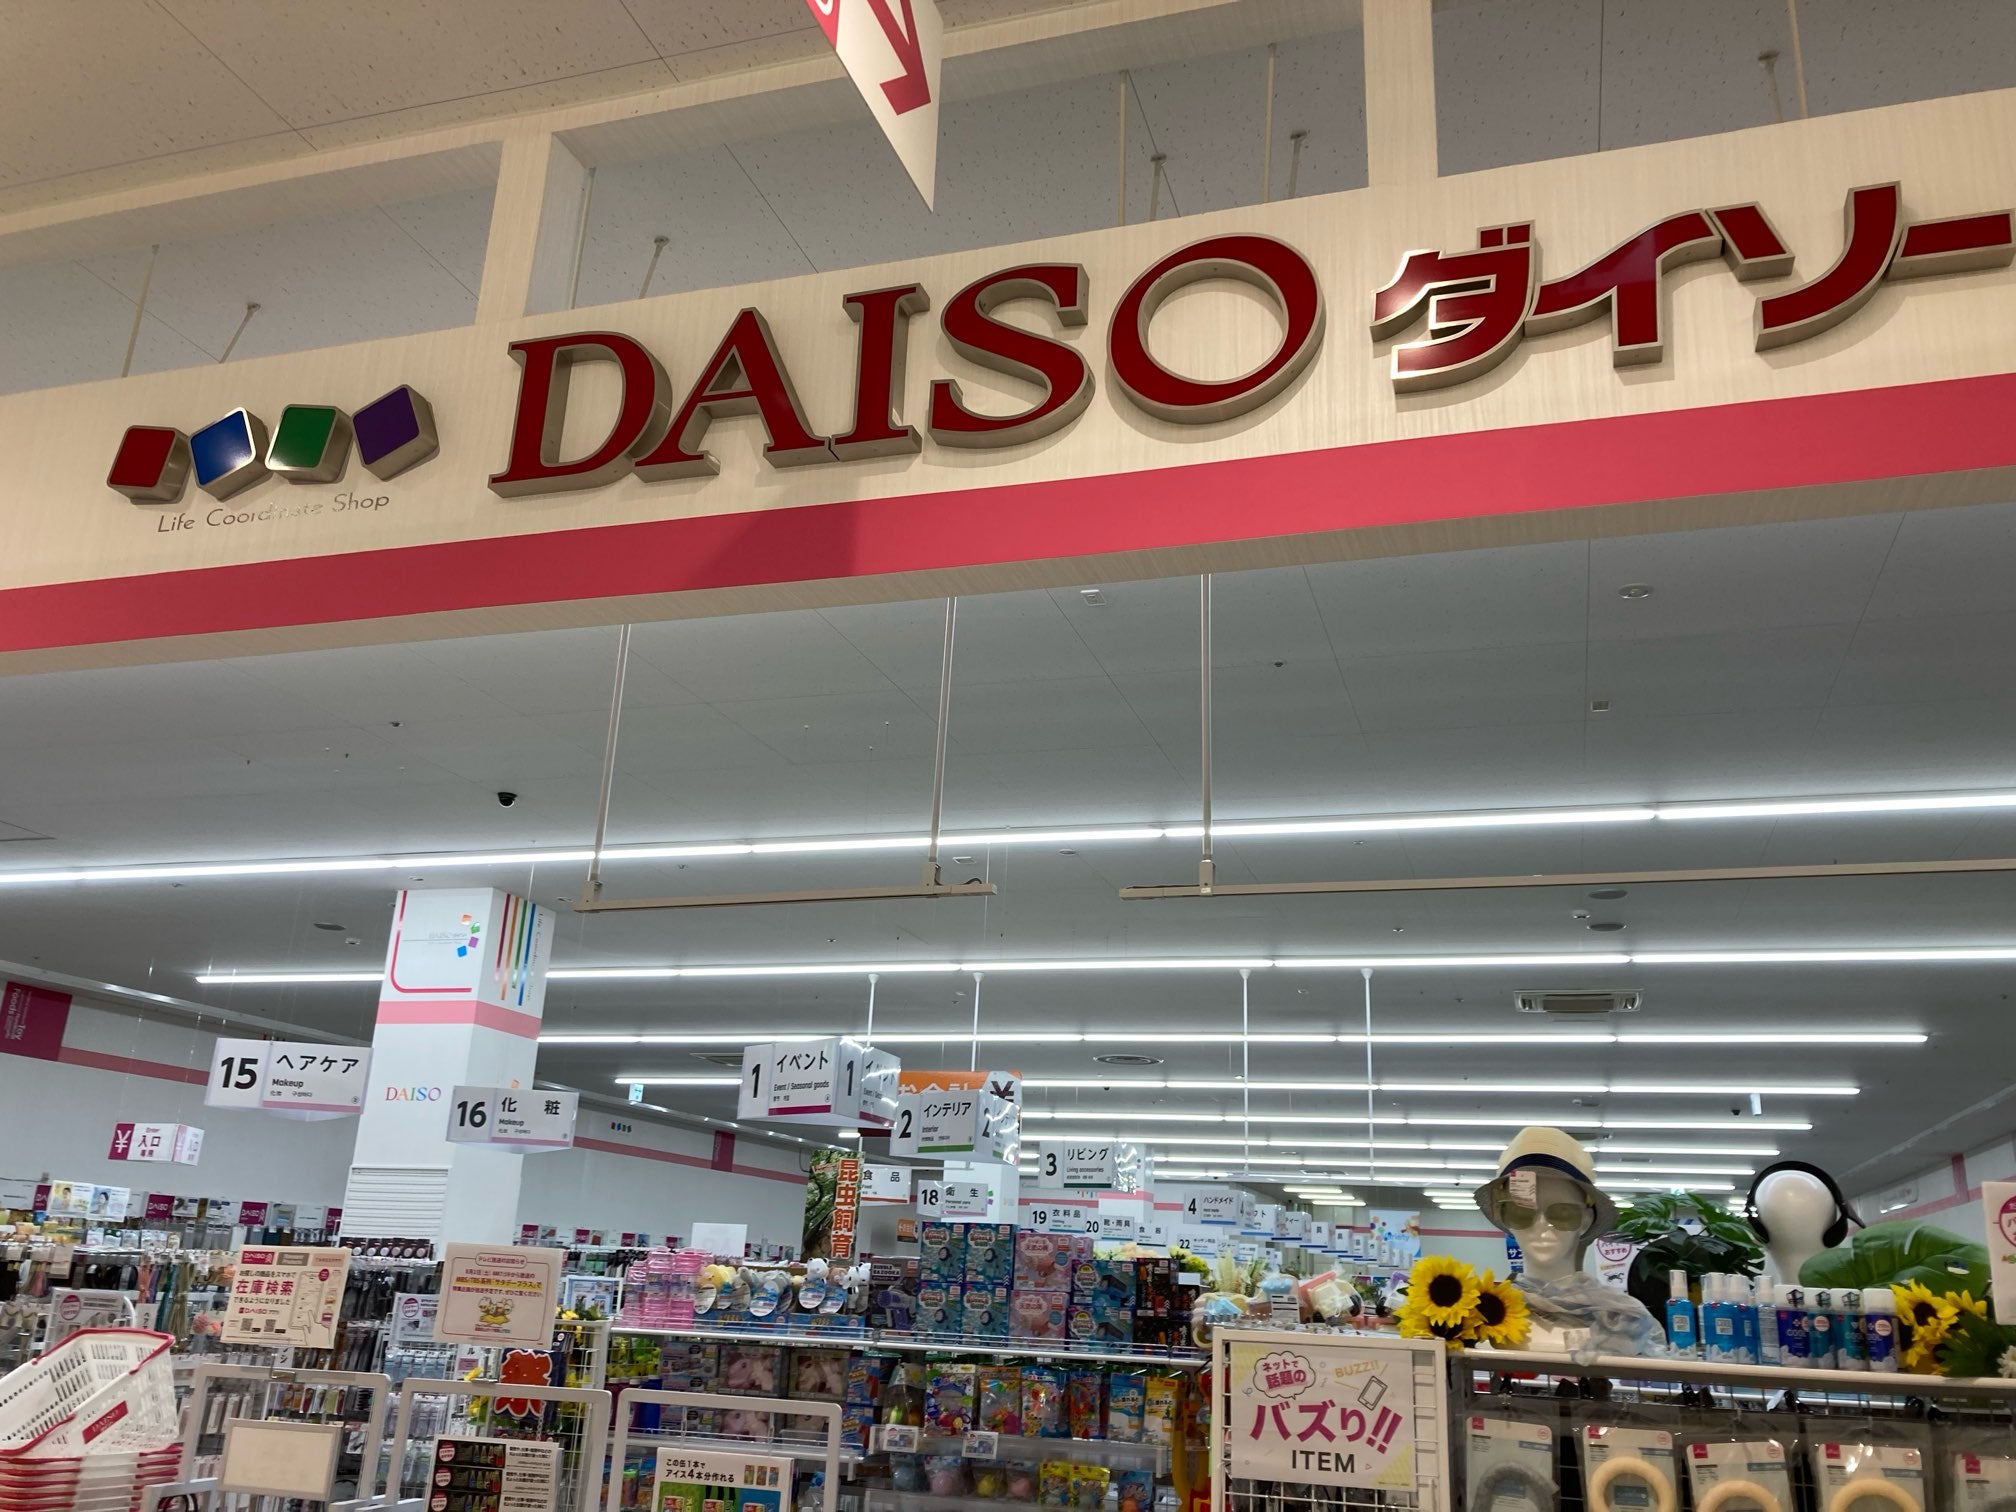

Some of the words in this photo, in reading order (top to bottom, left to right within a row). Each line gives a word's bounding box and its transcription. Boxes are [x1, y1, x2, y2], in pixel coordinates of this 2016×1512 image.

[1370, 181, 2015, 394] ダイソー
[488, 232, 1326, 497] DAISO
[157, 512, 195, 533] Life
[206, 503, 323, 526] Coordinate
[332, 493, 390, 513] Shop
[276, 1054, 359, 1074] ヘアケア
[776, 1050, 828, 1073] イベント
[221, 1057, 258, 1089] 15
[752, 1063, 761, 1098] 1
[847, 1060, 854, 1096] 1
[272, 1078, 304, 1088] Makeup
[773, 1083, 787, 1091] Event
[791, 1080, 813, 1090] Seasonal
[814, 1080, 829, 1090] goods
[384, 1086, 442, 1102] DAISO
[501, 1097, 561, 1115] 化粧
[923, 1102, 972, 1118] インテリア
[458, 1101, 487, 1128] 16
[499, 1119, 525, 1127] Makeup
[899, 1110, 912, 1138] 2
[922, 1126, 939, 1134] Interior
[138, 1135, 161, 1147] 入口
[1067, 1147, 1109, 1161] リビング
[1046, 1153, 1057, 1176] 3
[863, 1169, 900, 1182] 食品
[921, 1189, 939, 1206] 18
[946, 1186, 979, 1198] 衛生
[831, 1158, 858, 1259] 昆虫飼育
[1188, 1198, 1197, 1215] 4
[1203, 1197, 1234, 1205] ハンドメイド
[1032, 1211, 1047, 1224] 19
[1052, 1209, 1081, 1218] 衣料品
[1086, 1221, 1099, 1233] 20
[1103, 1219, 1131, 1228] 靴・雨具
[1179, 1240, 1190, 1249] 22
[236, 1280, 293, 1295] 在庫検索
[234, 1297, 290, 1305] できるようになりました
[1262, 1359, 1299, 1373] ネットで
[1334, 1359, 1380, 1378] BUZZ!!
[1265, 1369, 1308, 1391] 話題の
[1249, 1399, 1403, 1455] バズり!!
[666, 1458, 706, 1469] この缶1本で
[1291, 1449, 1356, 1474] ITEM
[665, 1469, 735, 1483] アイス4本分作れる
